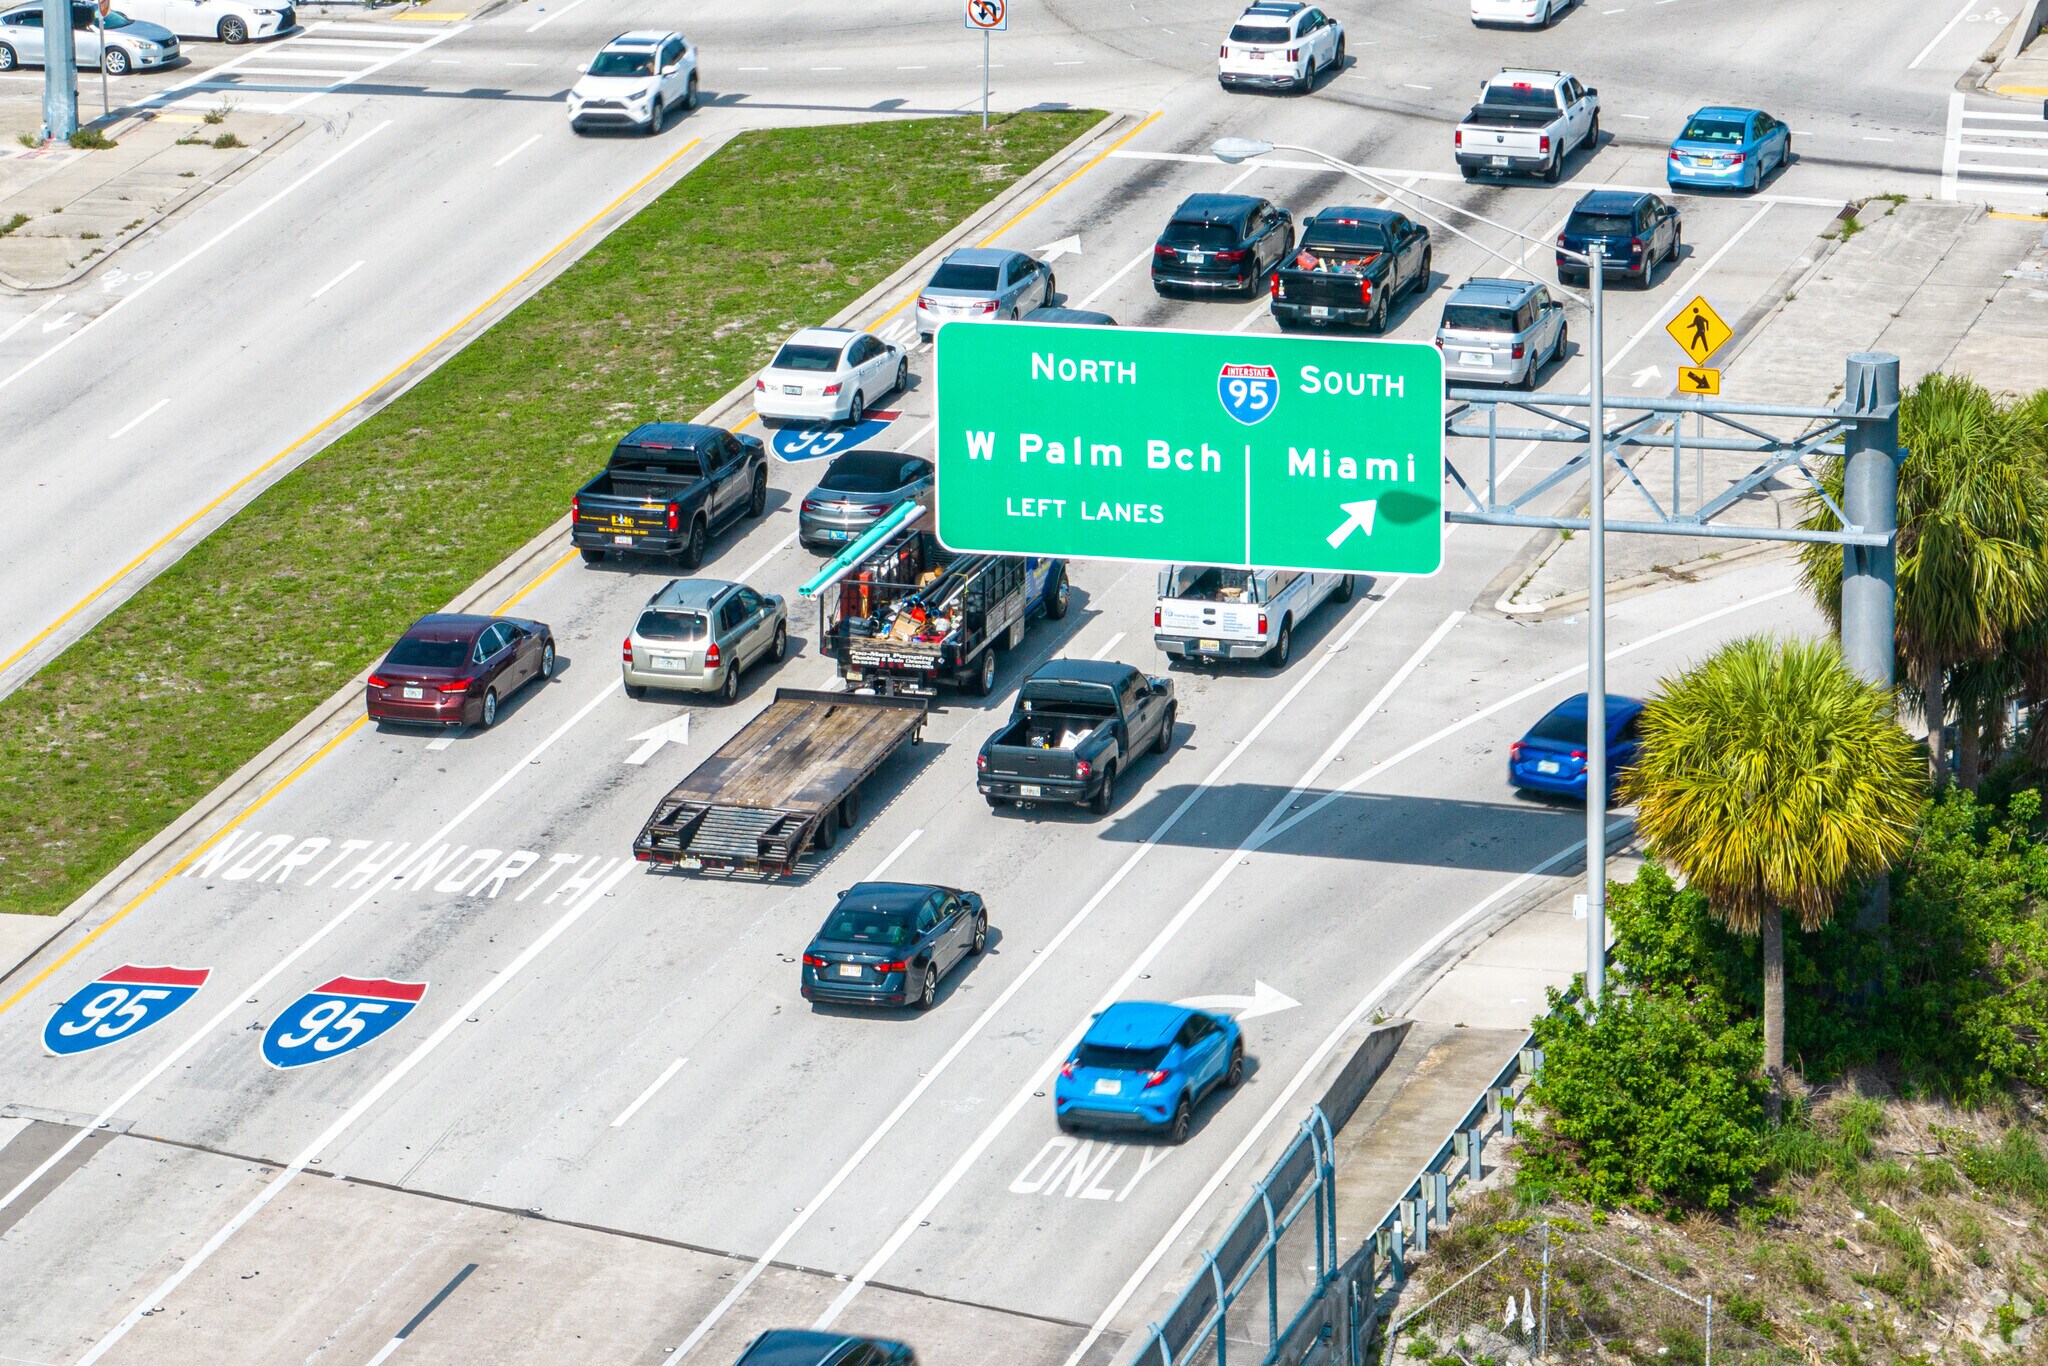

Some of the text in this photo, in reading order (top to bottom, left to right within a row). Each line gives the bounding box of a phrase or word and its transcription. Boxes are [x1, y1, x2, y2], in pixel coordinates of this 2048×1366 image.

[1032, 353, 1136, 384] NORTH
[1227, 367, 1270, 378] INTERSTATE
[1300, 366, 1404, 397] SOUTH
[1228, 379, 1269, 410] 95
[966, 431, 1221, 472] W Palm Bch
[1289, 448, 1415, 482] Miami
[1007, 498, 1164, 524] LEFT LANES
[893, 653, 934, 662] Pumping
[181, 829, 412, 889] NORTH
[391, 843, 620, 905] NORTH
[59, 988, 171, 1038] 95
[277, 1000, 390, 1051] 95
[1008, 1136, 1176, 1201] ONLY
